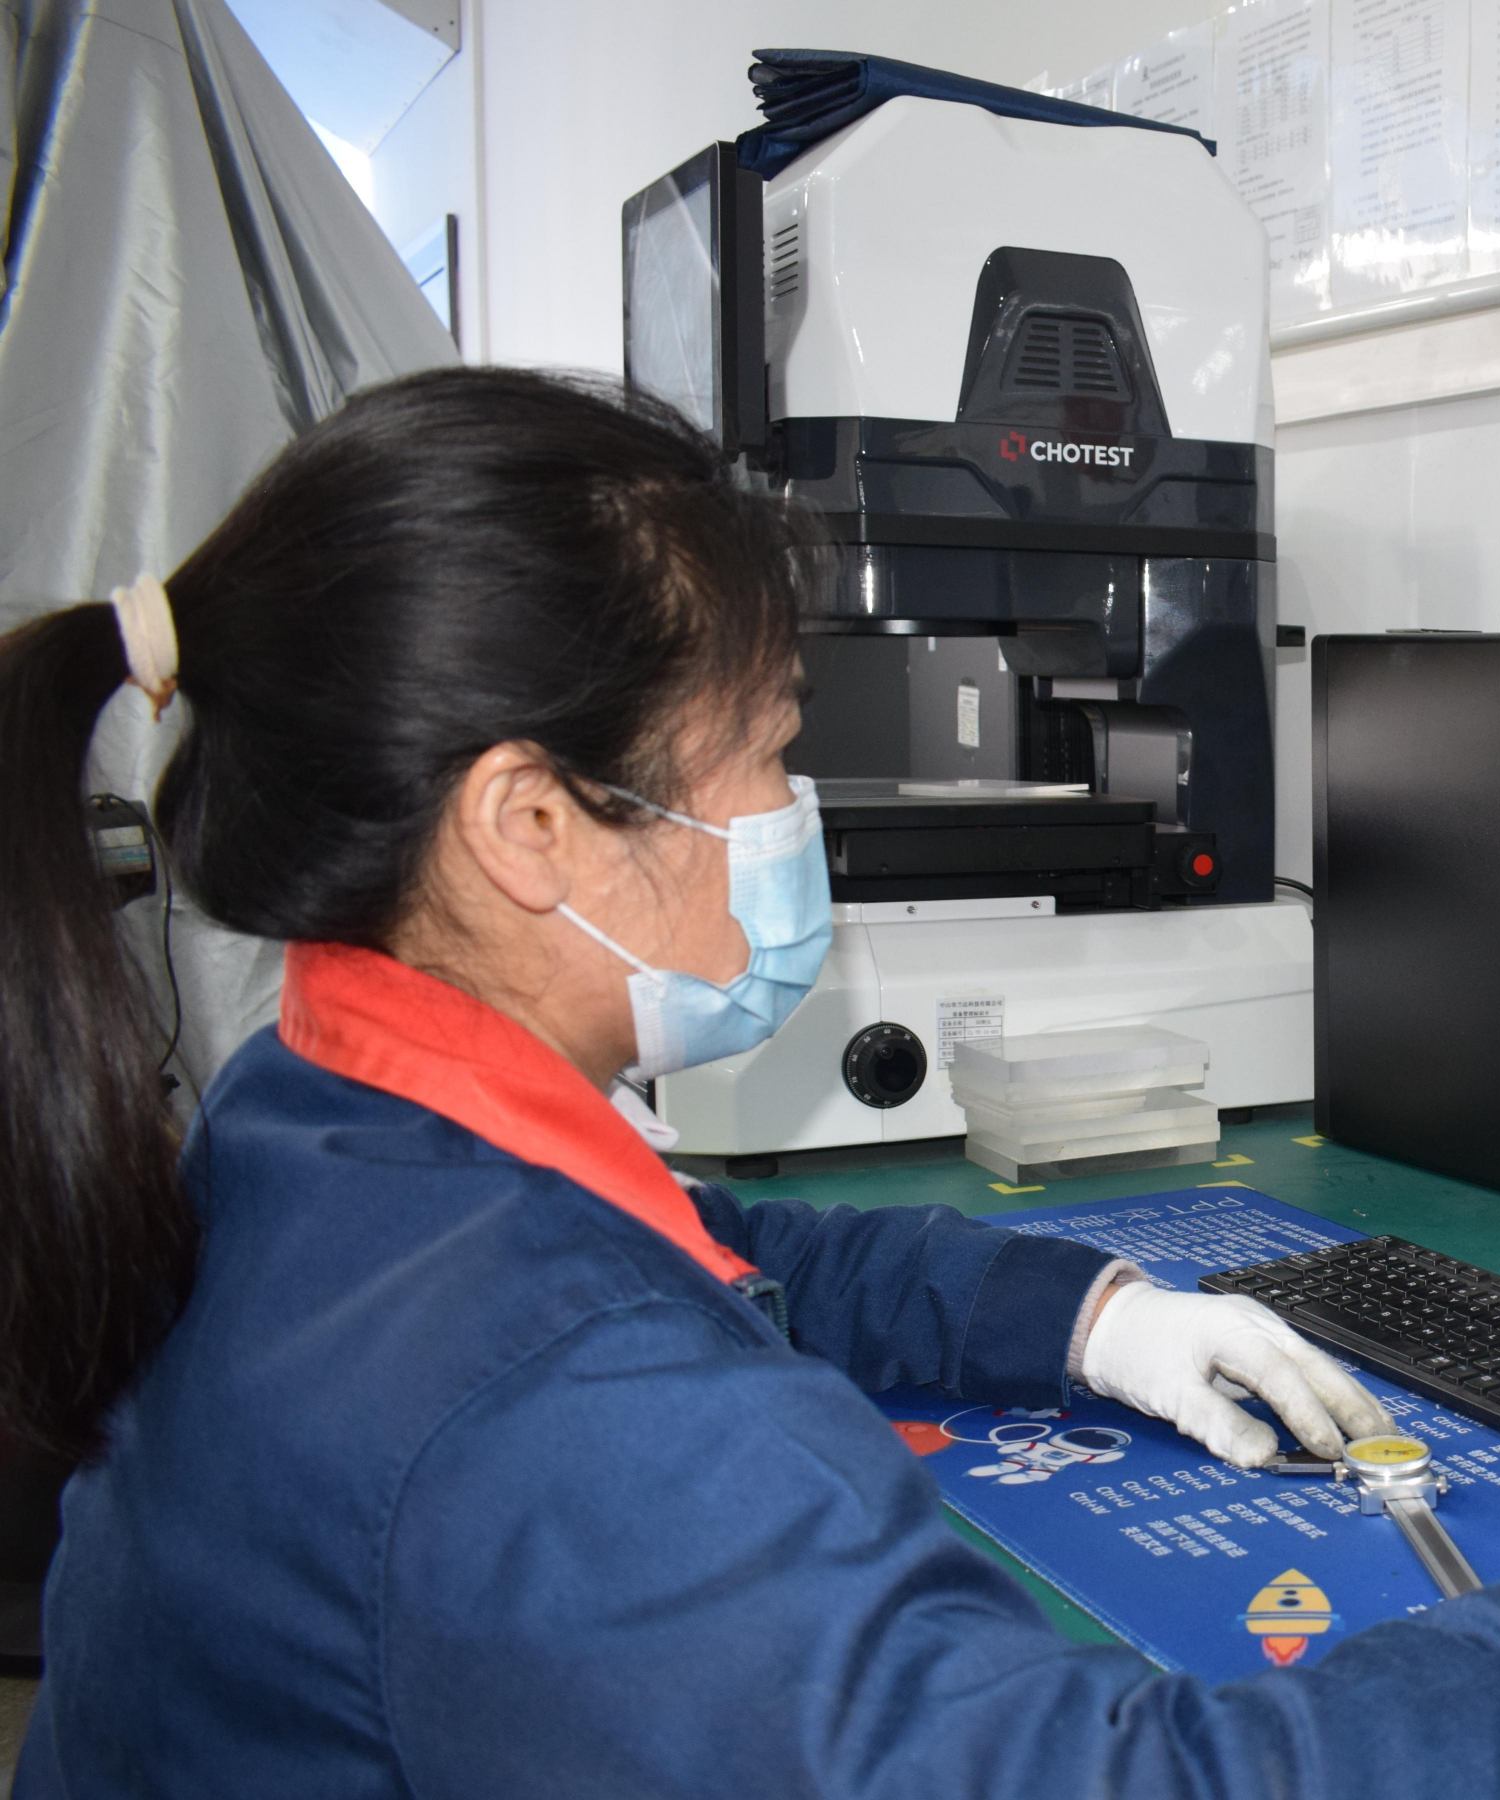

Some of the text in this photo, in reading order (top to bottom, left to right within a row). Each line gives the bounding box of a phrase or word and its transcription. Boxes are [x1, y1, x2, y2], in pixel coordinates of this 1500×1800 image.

[1030, 441, 1134, 466] CHOTEST
[1147, 1475, 1185, 1496] Ctrl+S
[1173, 1470, 1212, 1491] Ctrl+R
[1198, 1465, 1237, 1486] Ctrl+Q
[1069, 1491, 1111, 1515] Ctrl+W
[1095, 1486, 1136, 1508] Ctrl+U
